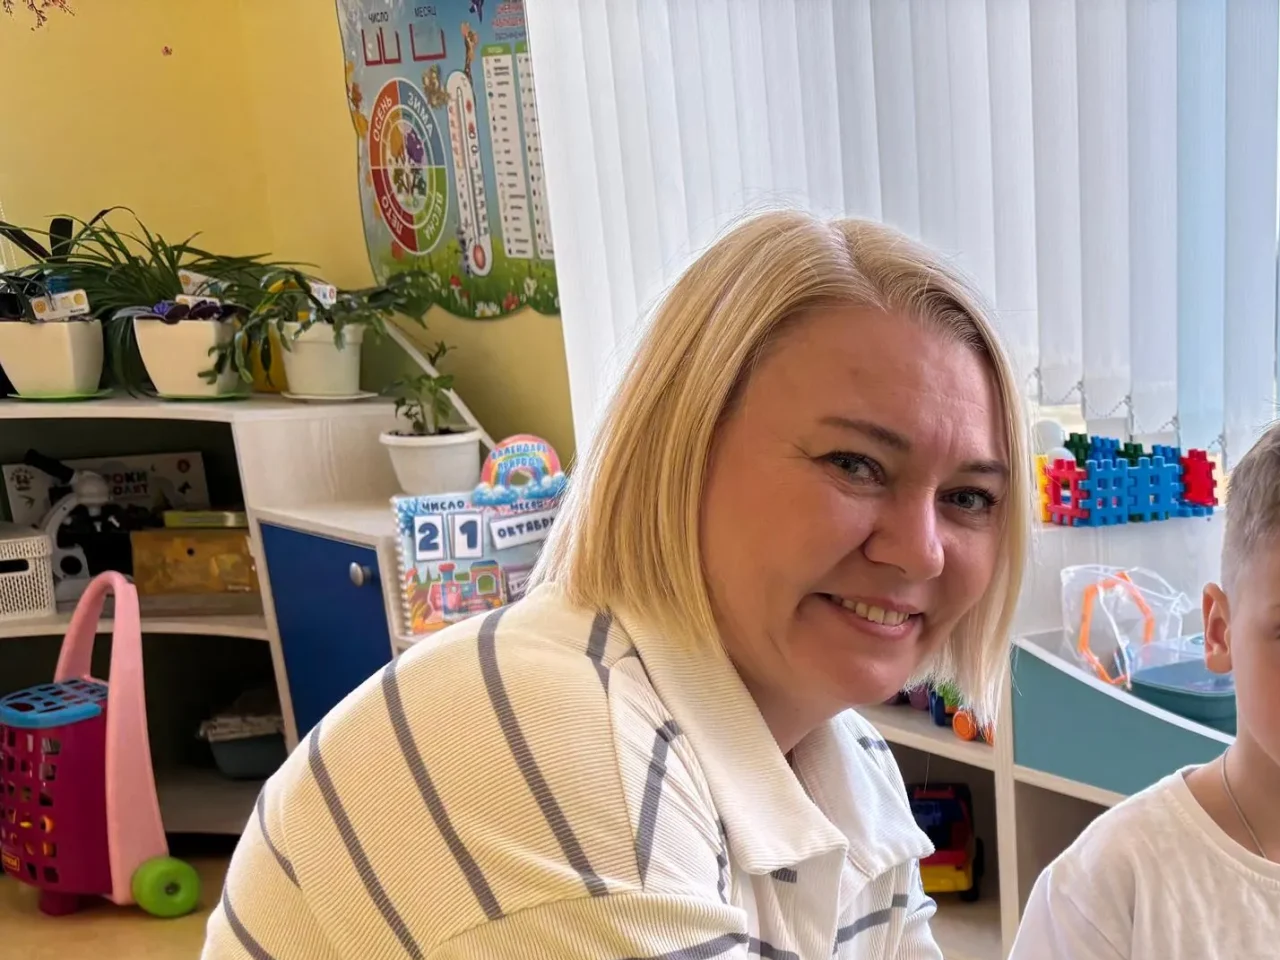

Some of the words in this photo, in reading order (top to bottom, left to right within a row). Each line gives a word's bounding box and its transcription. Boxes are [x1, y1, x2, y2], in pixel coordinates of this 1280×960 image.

[368, 11, 389, 23] ЧИСЛО
[373, 97, 393, 142] ОСЕНЬ
[407, 92, 434, 137] ЗИМА
[381, 196, 405, 235] ЛЕТО
[423, 191, 443, 240] ВЕСНА
[422, 500, 465, 512] ЧИСЛО
